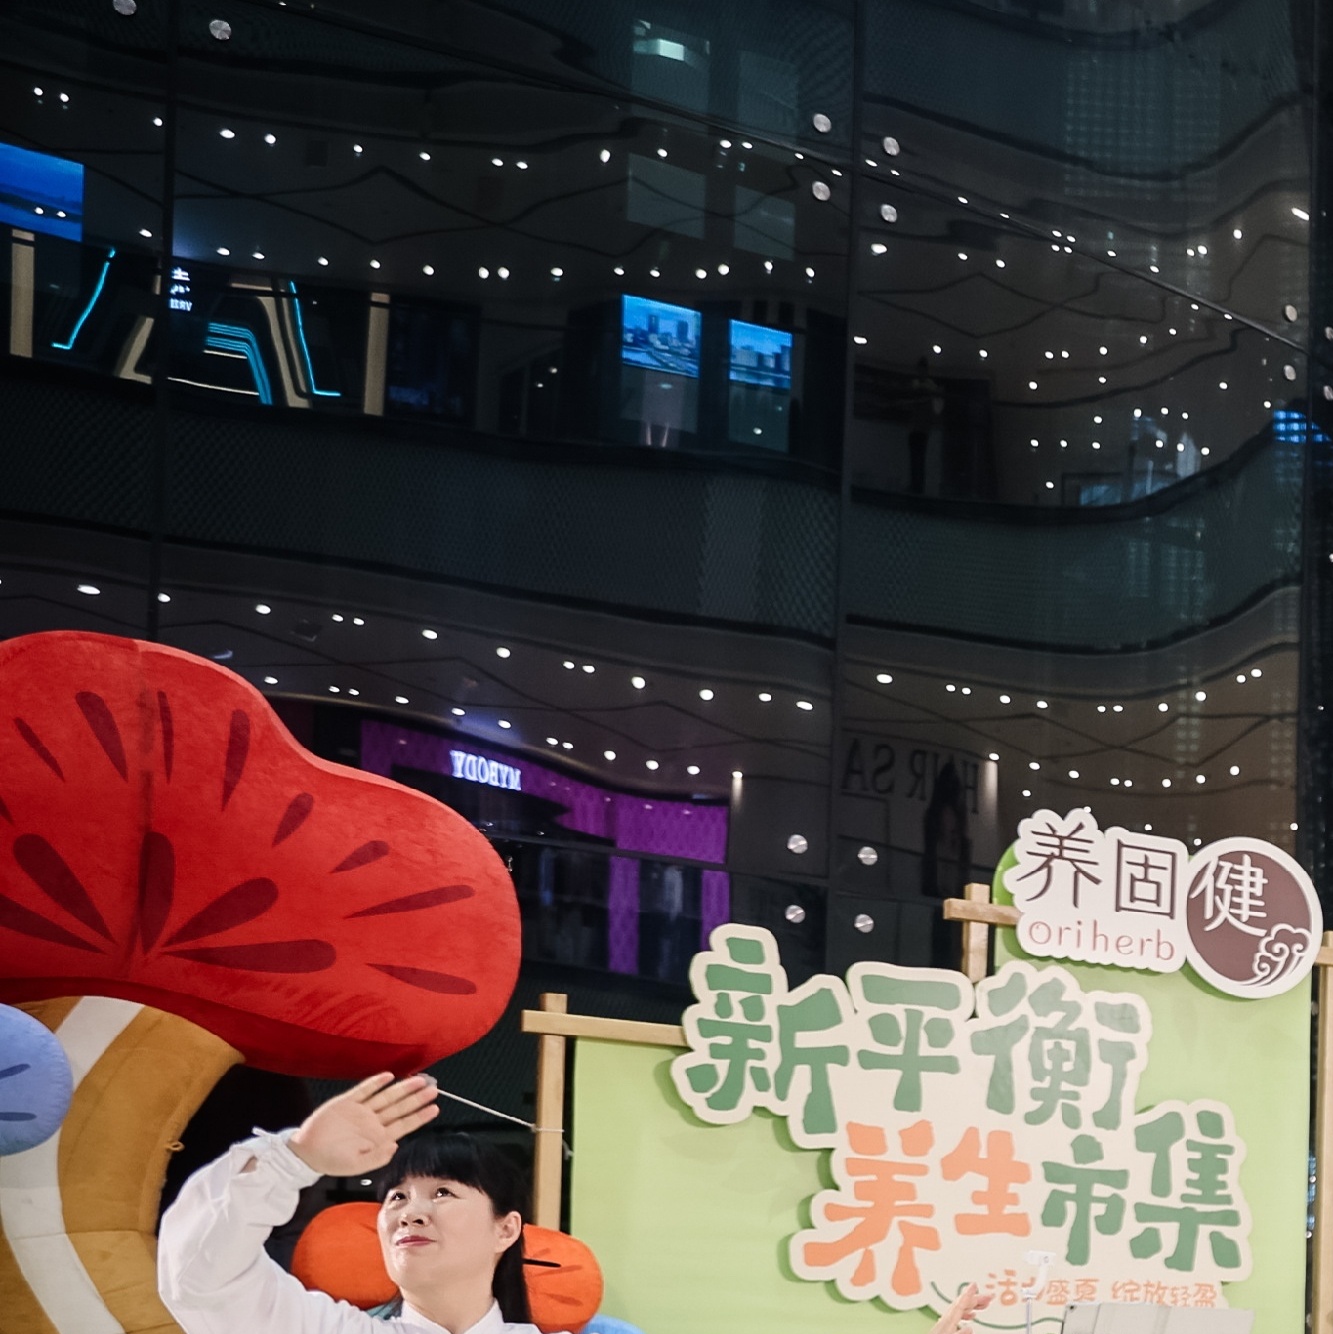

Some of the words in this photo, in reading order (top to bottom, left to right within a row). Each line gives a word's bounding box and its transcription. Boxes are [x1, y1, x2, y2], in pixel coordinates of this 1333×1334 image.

[1016, 822, 1268, 936] 养固健
[1028, 919, 1175, 961] oriherb
[686, 937, 1142, 1134] 新平衡
[803, 1109, 1242, 1296] 养生市集
